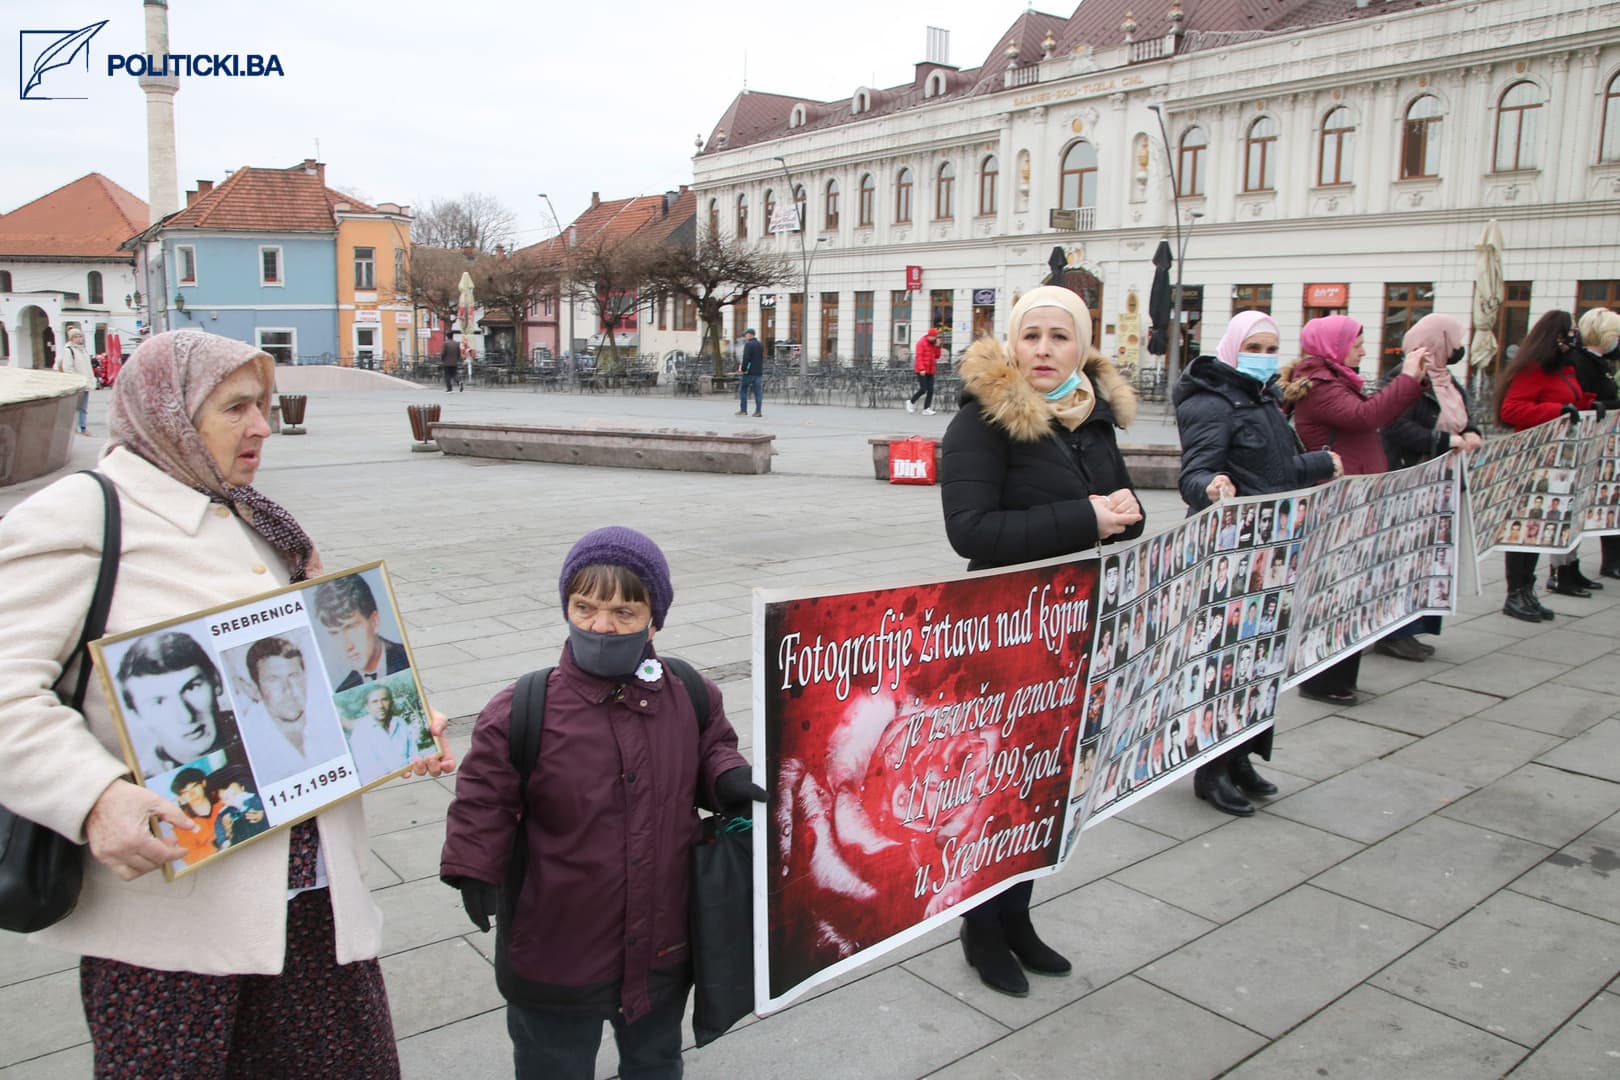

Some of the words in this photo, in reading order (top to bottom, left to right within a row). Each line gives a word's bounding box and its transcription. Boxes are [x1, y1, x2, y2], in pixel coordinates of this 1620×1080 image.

[211, 601, 304, 637] SREBRENICA
[778, 608, 912, 700] Fotografije
[919, 608, 991, 664] žrtava
[996, 586, 1038, 648] nad
[1039, 584, 1089, 655] kojim
[894, 698, 924, 769] je
[928, 681, 1004, 745] izvršen
[1001, 653, 1088, 739] genocid
[268, 766, 352, 807] 11.7.1995.
[902, 769, 932, 826] 11
[926, 752, 975, 833] jula
[914, 862, 931, 899] u
[931, 799, 1059, 898] Srebrenici
